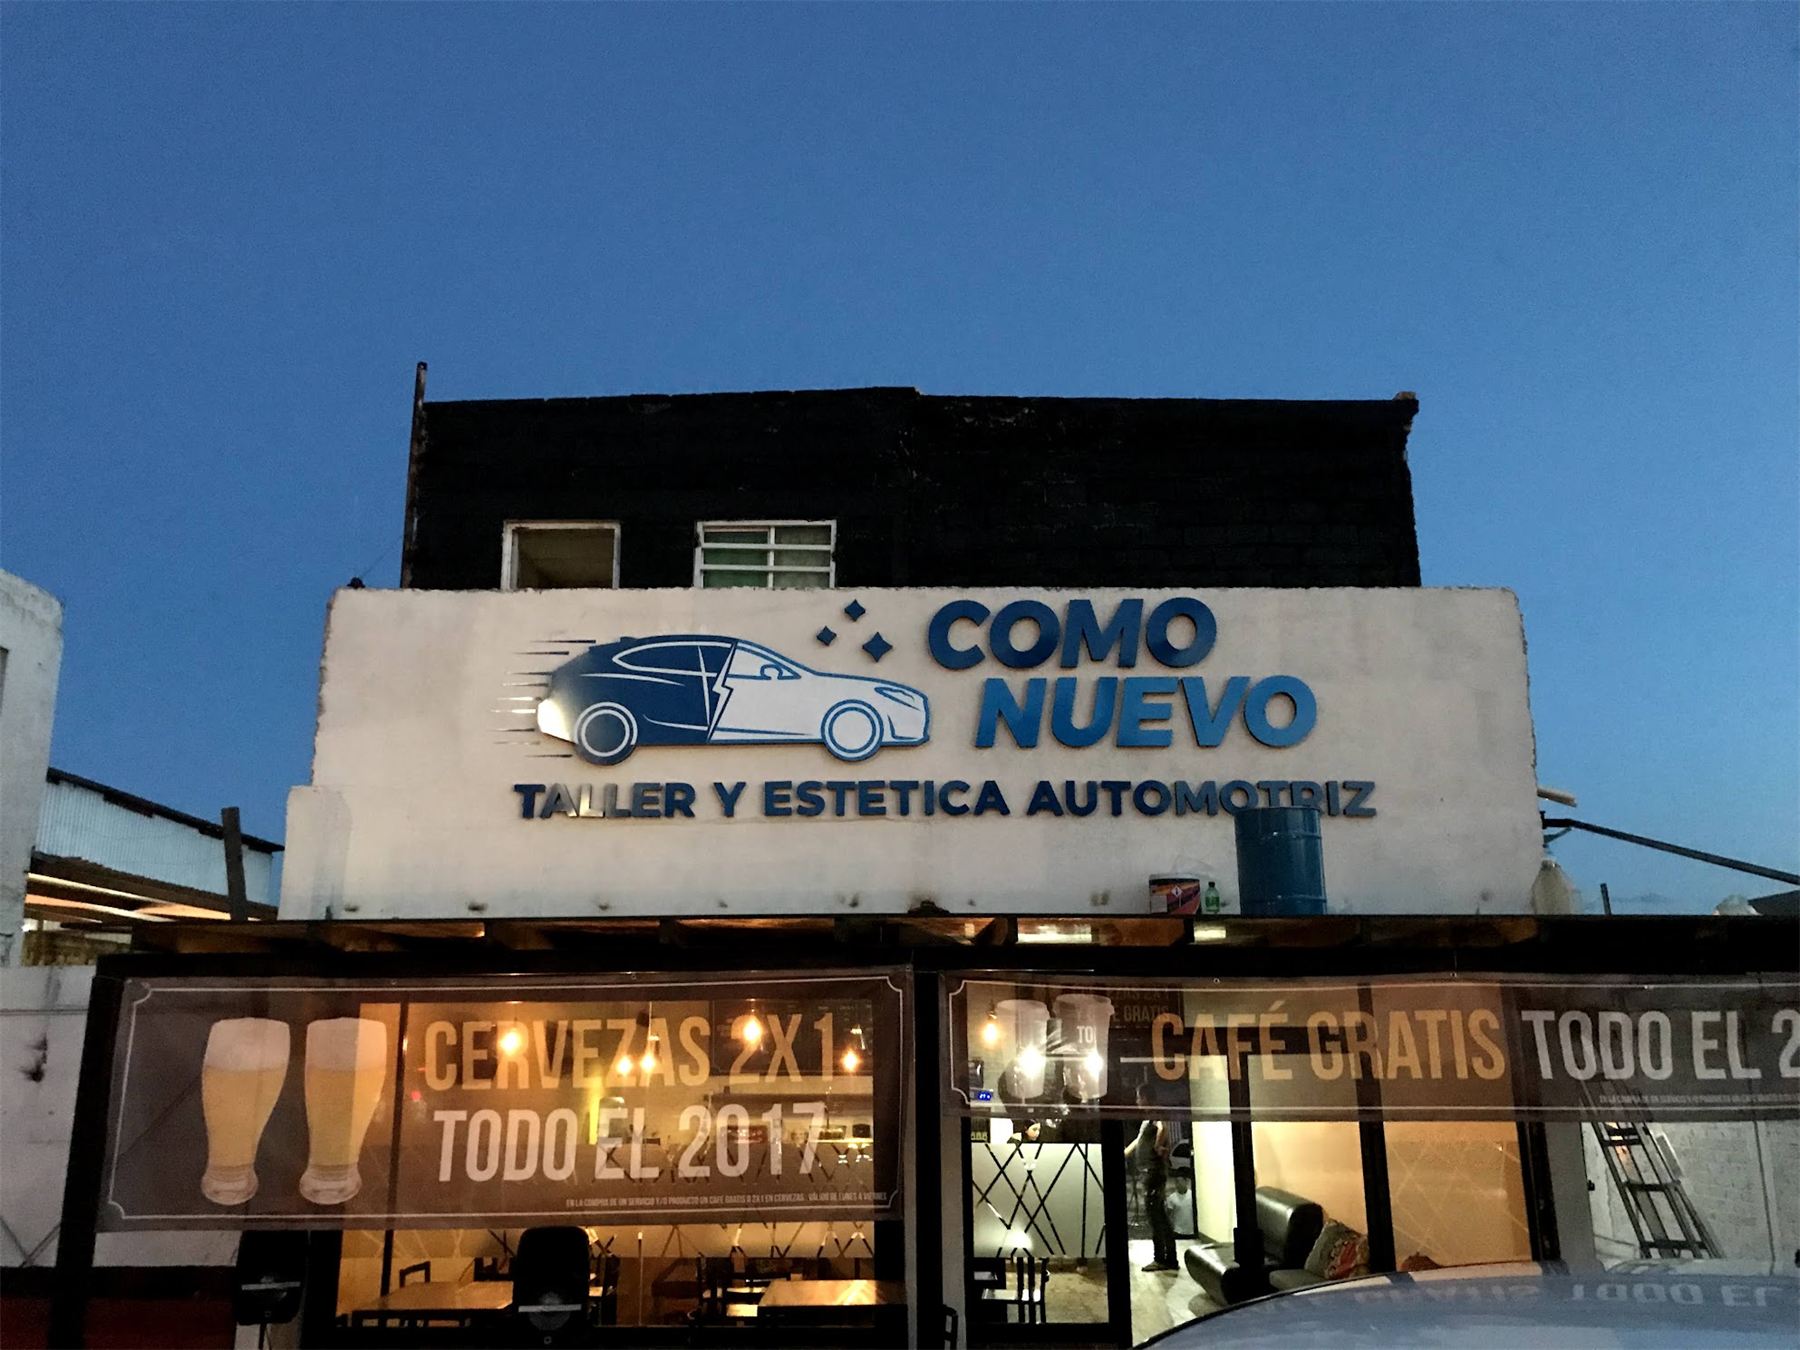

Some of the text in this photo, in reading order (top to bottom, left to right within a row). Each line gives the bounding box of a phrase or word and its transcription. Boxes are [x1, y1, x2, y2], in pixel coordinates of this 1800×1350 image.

[928, 597, 1217, 670] COMO
[975, 675, 1317, 748] NUEVO
[514, 780, 1377, 819] TALLER Y ESTETICA AUTOMOTRIZ
[424, 1016, 711, 1091] CERVEZAS
[1151, 1000, 1294, 1081] CAFÉ
[1306, 1009, 1506, 1081] GRATIS
[1521, 1010, 1674, 1080] TODO
[1691, 1010, 1762, 1080] EL
[433, 1102, 826, 1183] TODO EL 2017
